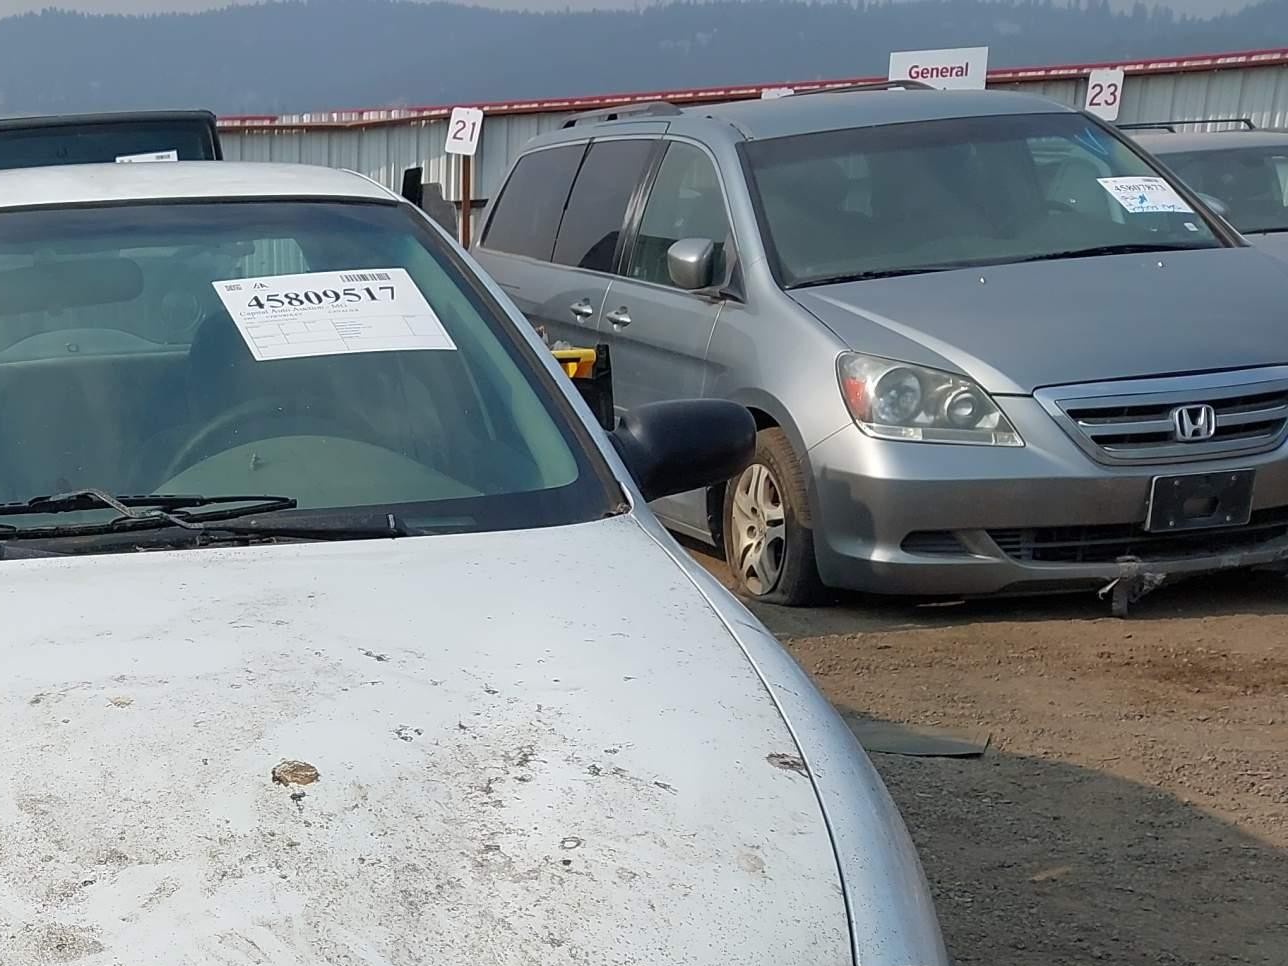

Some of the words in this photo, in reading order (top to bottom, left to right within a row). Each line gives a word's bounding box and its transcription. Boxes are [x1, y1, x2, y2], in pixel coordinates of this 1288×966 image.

[908, 62, 969, 80] General
[1088, 83, 1117, 107] 23
[452, 120, 477, 143] 21
[247, 286, 395, 310] 45809517
